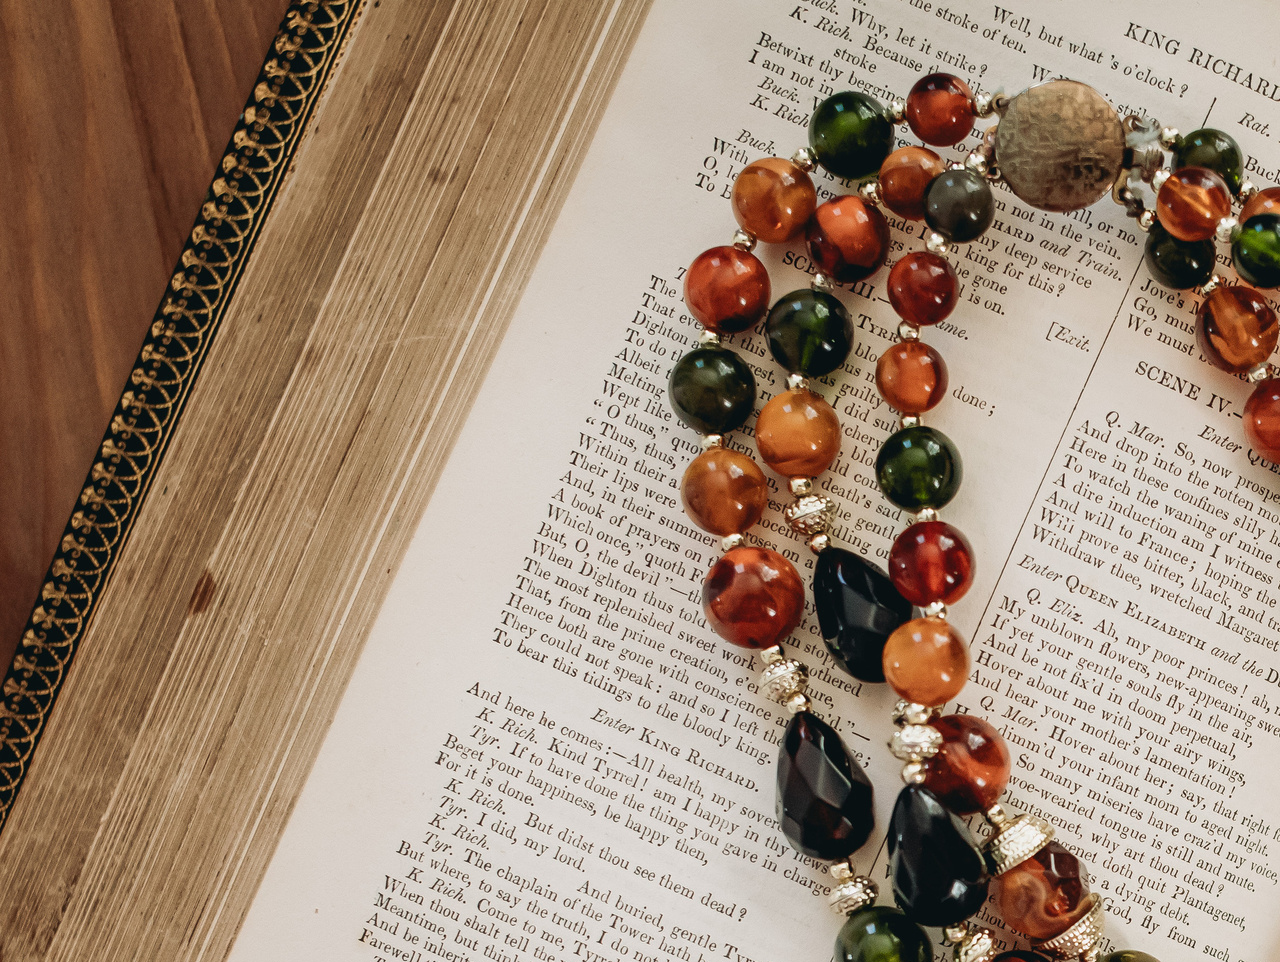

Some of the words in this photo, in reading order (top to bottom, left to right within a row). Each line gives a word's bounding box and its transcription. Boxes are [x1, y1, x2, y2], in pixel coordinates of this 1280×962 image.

[756, 31, 815, 68] Betwixt
[819, 59, 844, 82] thy
[788, 5, 809, 24] K.
[813, 15, 853, 43] Rich.
[862, 34, 923, 72] Because
[833, 48, 877, 73] stroke
[1123, 21, 1181, 55] KING
[1237, 112, 1270, 137] Rat.
[1134, 360, 1201, 401] SCENE
[1069, 435, 1107, 464] Here
[1111, 454, 1127, 473] in
[1133, 466, 1169, 492] these
[1232, 514, 1266, 540] slily
[1017, 554, 1063, 582] Enter
[1210, 647, 1242, 665] and
[1241, 659, 1264, 677] the
[492, 627, 513, 648] To
[516, 639, 549, 664] bear
[552, 656, 579, 678] this
[583, 671, 633, 703] tidings
[637, 695, 651, 710] to
[656, 702, 679, 722] the
[682, 713, 732, 748] bloody
[735, 736, 771, 766] king.
[590, 707, 635, 735] Enter
[434, 750, 462, 772] For
[464, 764, 478, 780] it
[481, 771, 494, 788] is
[497, 780, 543, 807] done.
[365, 912, 400, 936] And
[402, 927, 419, 945] be
